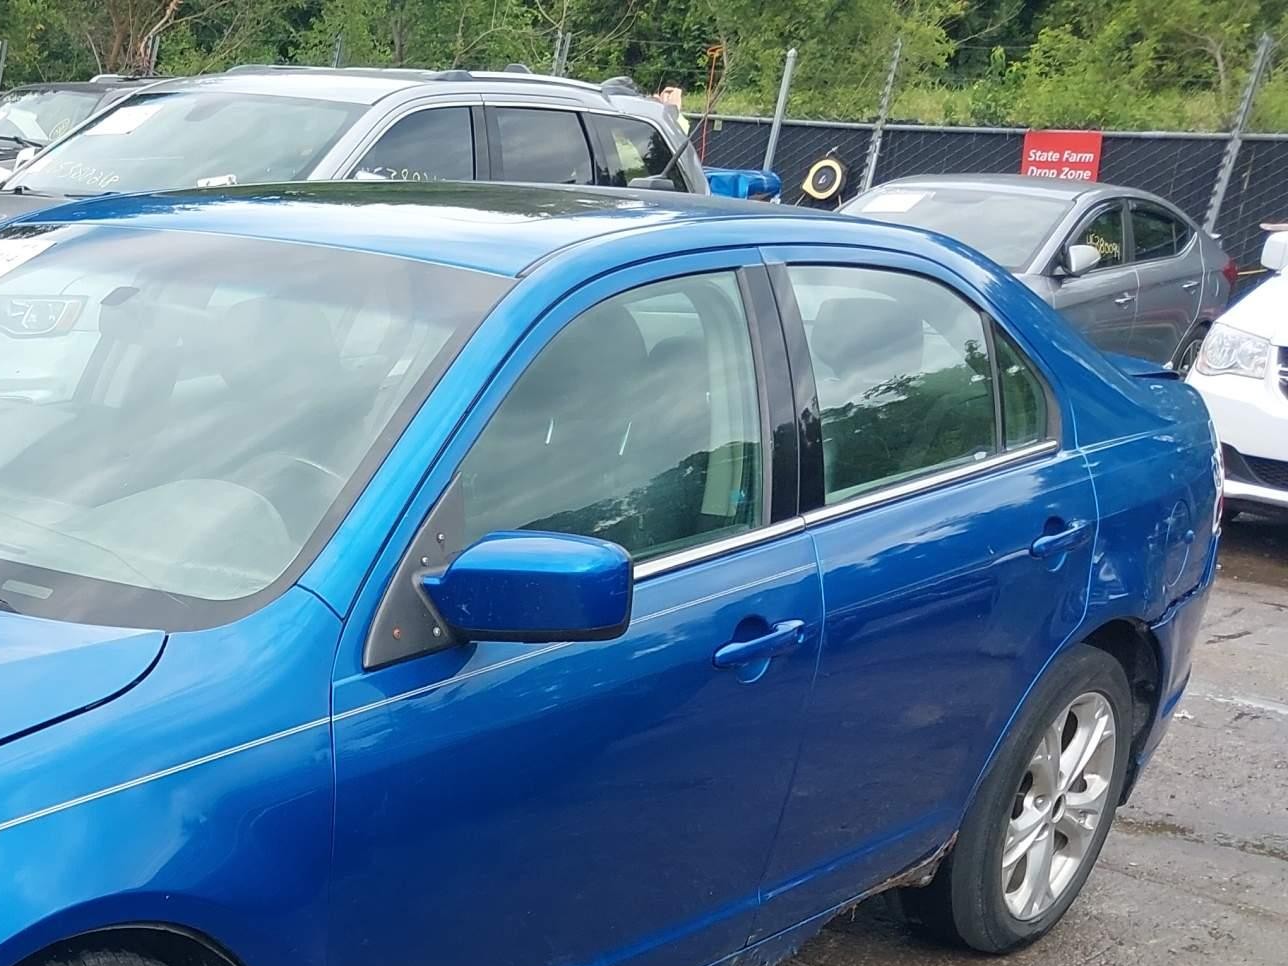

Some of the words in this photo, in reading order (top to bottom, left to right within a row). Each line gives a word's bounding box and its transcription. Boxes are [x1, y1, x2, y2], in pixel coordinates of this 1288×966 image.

[1027, 149, 1060, 162] State
[1062, 150, 1094, 163] Farm
[1059, 167, 1092, 180] Zone
